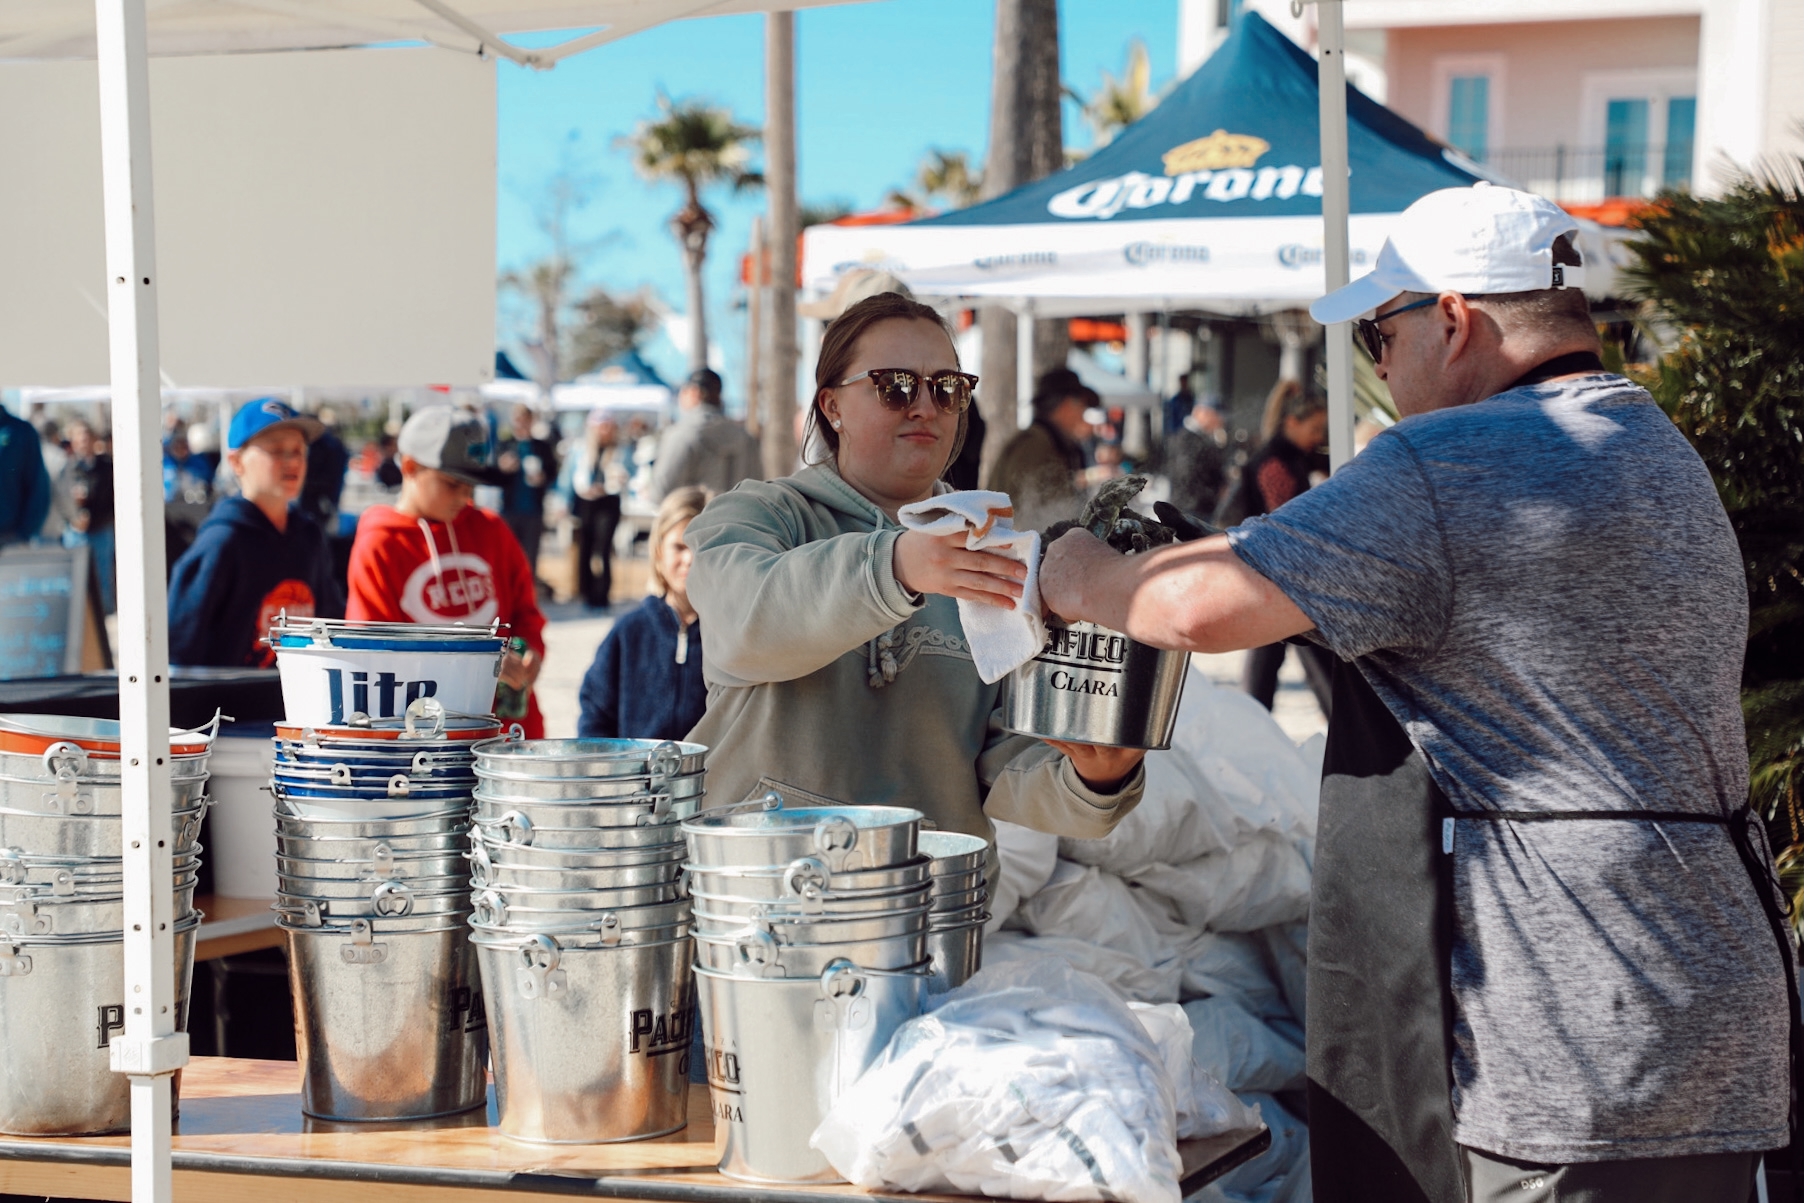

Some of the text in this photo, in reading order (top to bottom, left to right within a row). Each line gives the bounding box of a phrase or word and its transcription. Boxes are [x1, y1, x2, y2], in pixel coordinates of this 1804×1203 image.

[1123, 241, 1211, 267] Corona
[1278, 244, 1366, 270] Cora
[1041, 626, 1127, 663] IFICO
[322, 667, 437, 725] lite
[1051, 670, 1118, 697] CLARA
[710, 1099, 744, 1124] LARA
